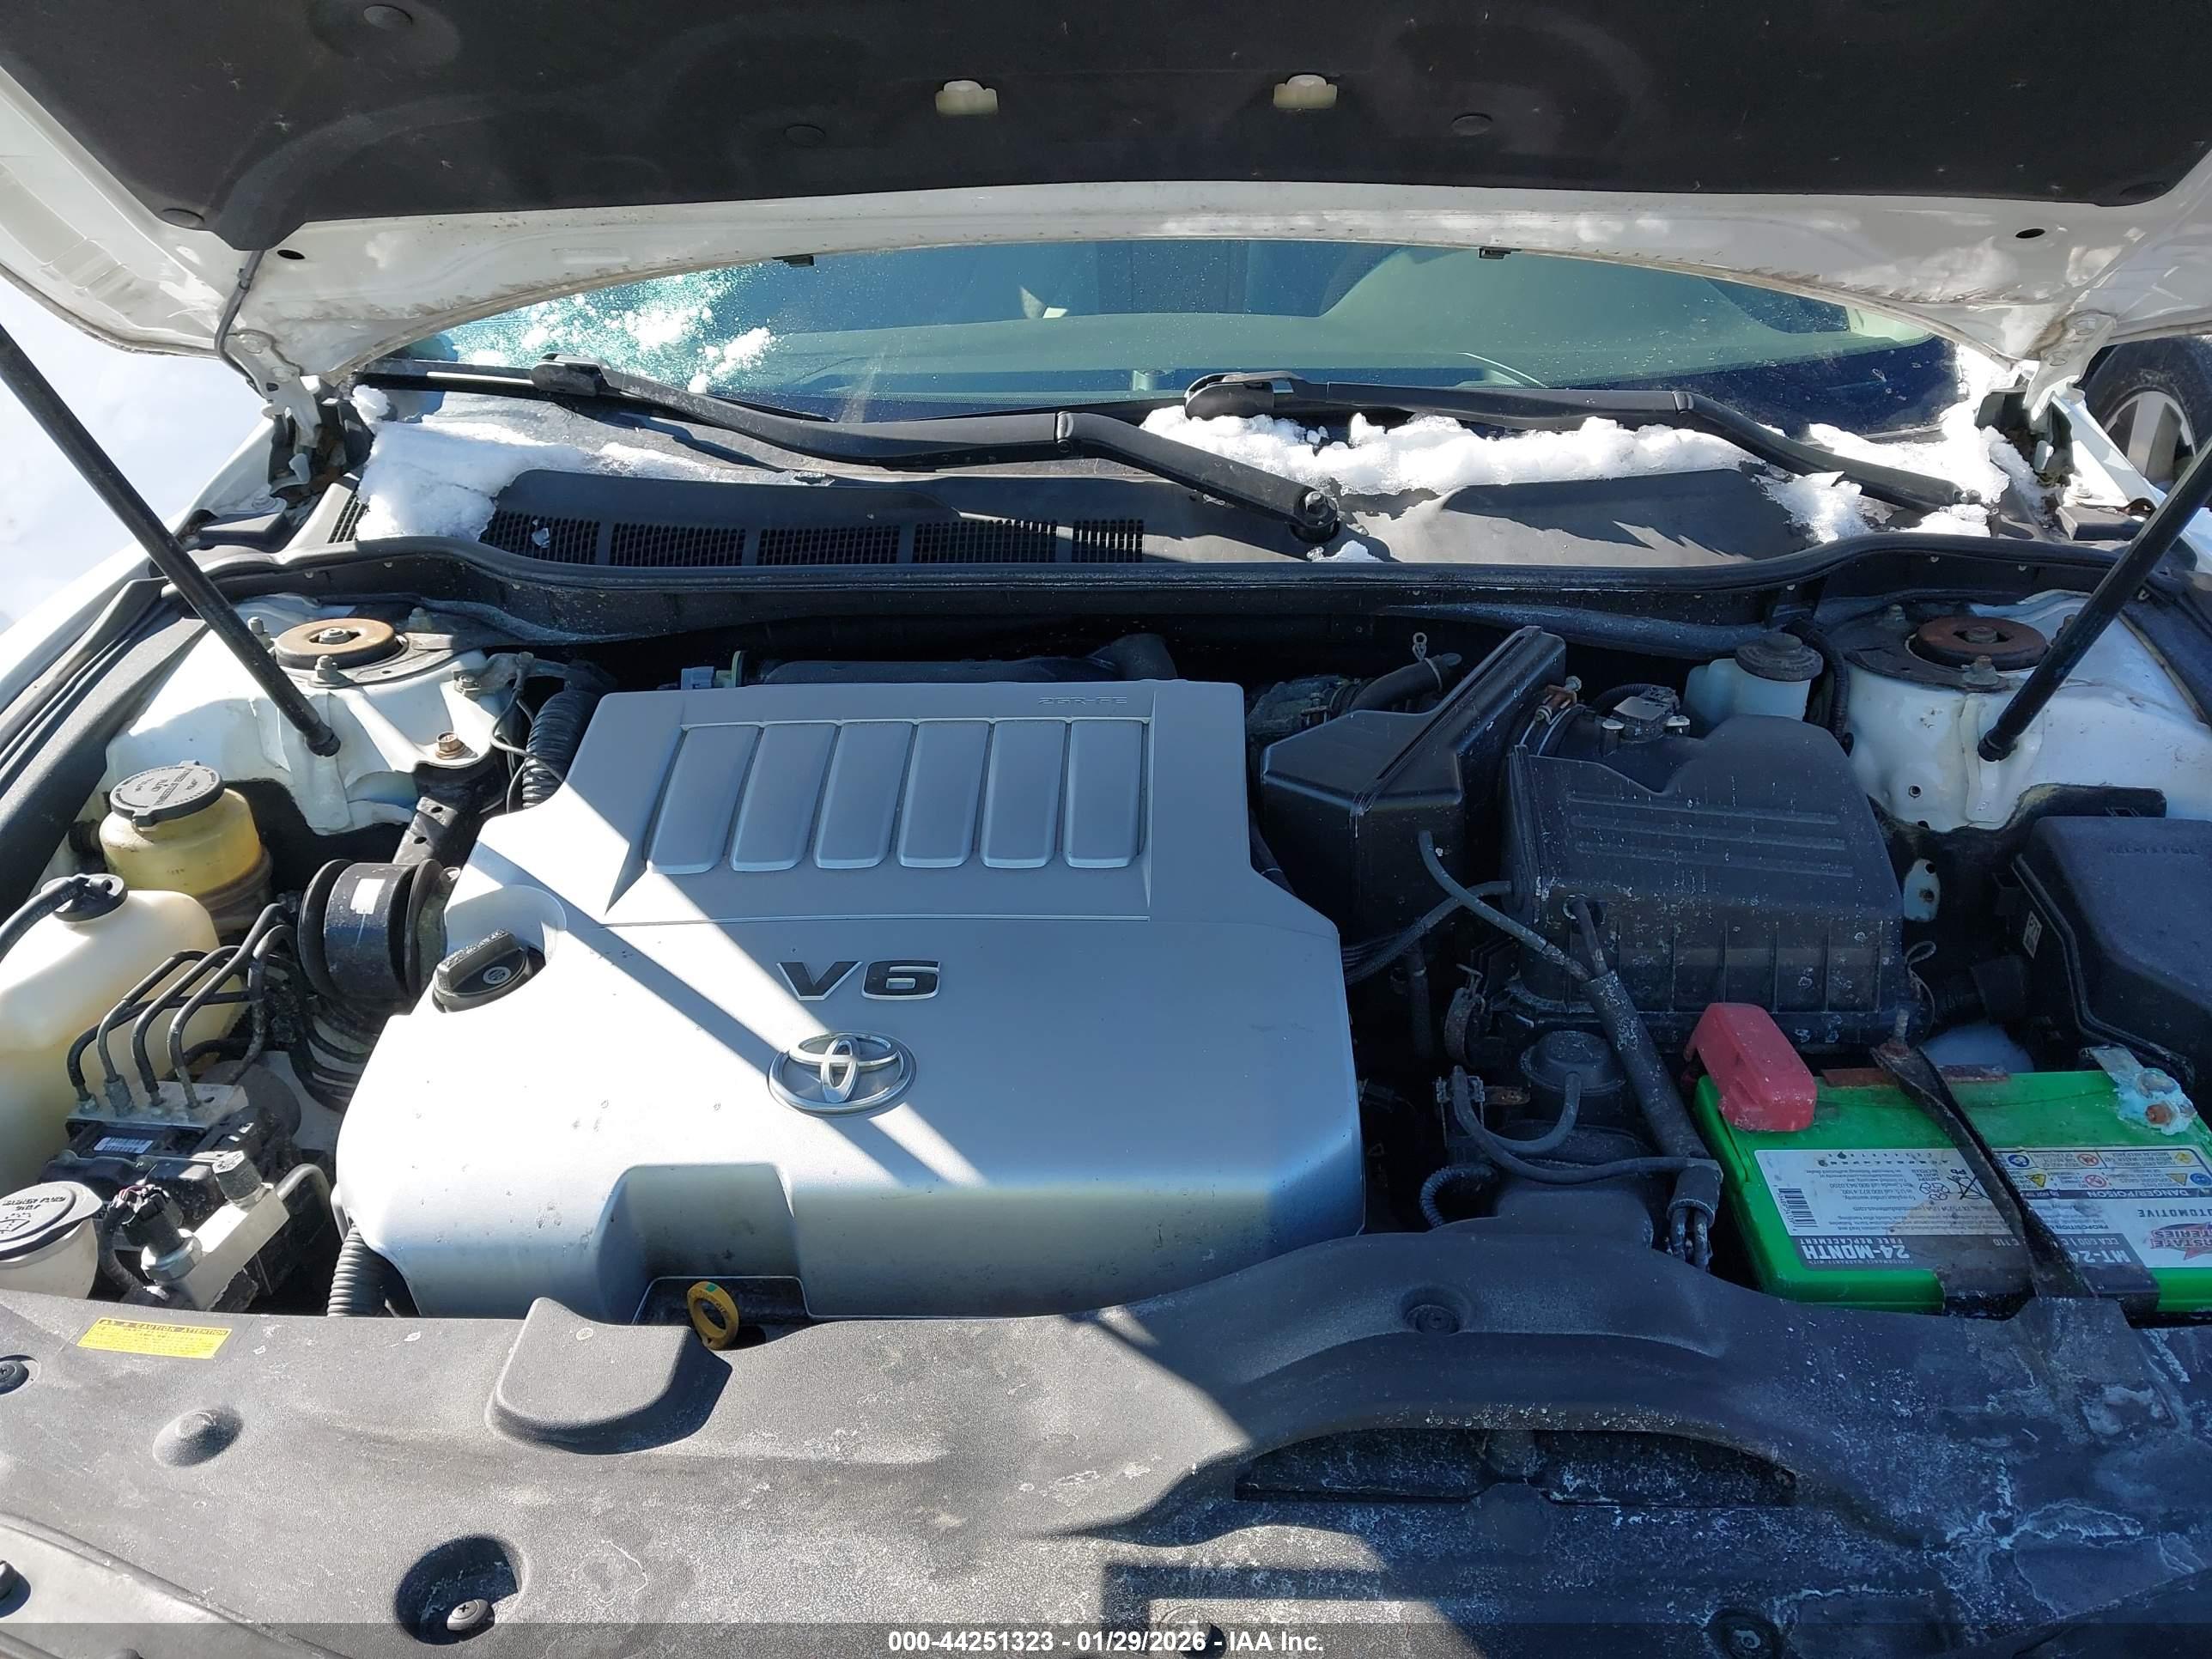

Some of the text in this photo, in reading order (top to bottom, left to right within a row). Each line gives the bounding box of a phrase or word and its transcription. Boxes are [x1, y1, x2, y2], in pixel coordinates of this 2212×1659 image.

[1037, 696, 1127, 706] 2GR-FE
[776, 959, 940, 1001] V6
[2087, 1189, 2189, 1199] DANGER/POISON
[1802, 1244, 1911, 1259] 24-MONTH
[136, 1323, 175, 1332] CAUTION
[181, 1327, 228, 1335] ATTENTION
